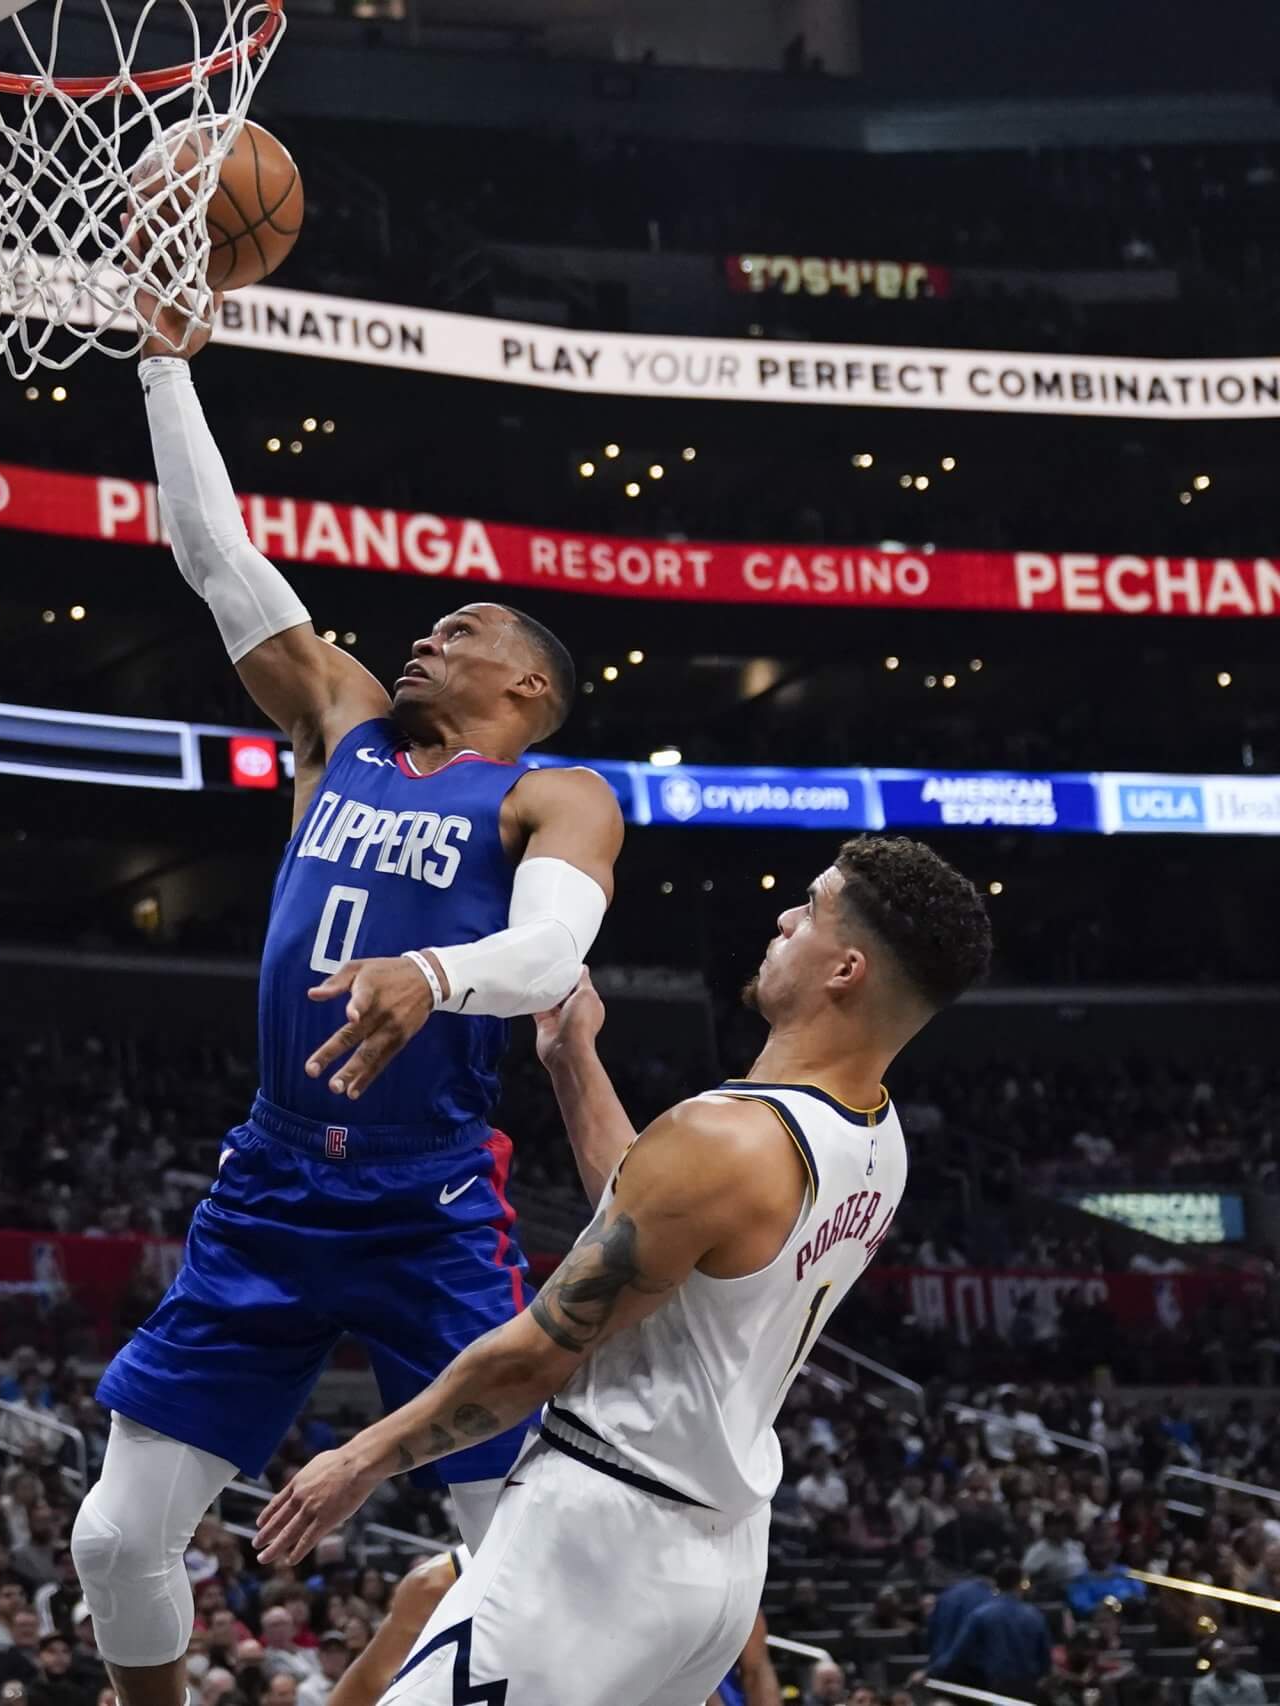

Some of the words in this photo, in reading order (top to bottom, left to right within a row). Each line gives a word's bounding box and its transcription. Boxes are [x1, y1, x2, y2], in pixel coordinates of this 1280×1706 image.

[220, 299, 427, 355] BINATION
[501, 338, 600, 378] PLAY
[622, 348, 740, 387] YOUR
[757, 358, 948, 396] PERFECT
[967, 367, 1280, 406] COMBINATION
[529, 537, 714, 588] RESORT
[742, 551, 930, 596] CASINO
[702, 783, 849, 814] crypto.com
[921, 777, 1053, 802] AMERICAN
[941, 802, 1058, 825] EXPRESS
[1125, 790, 1197, 819] UCLA
[297, 790, 472, 888] CLIPPERS
[310, 884, 369, 974] 0
[796, 1190, 882, 1281] PORTER
